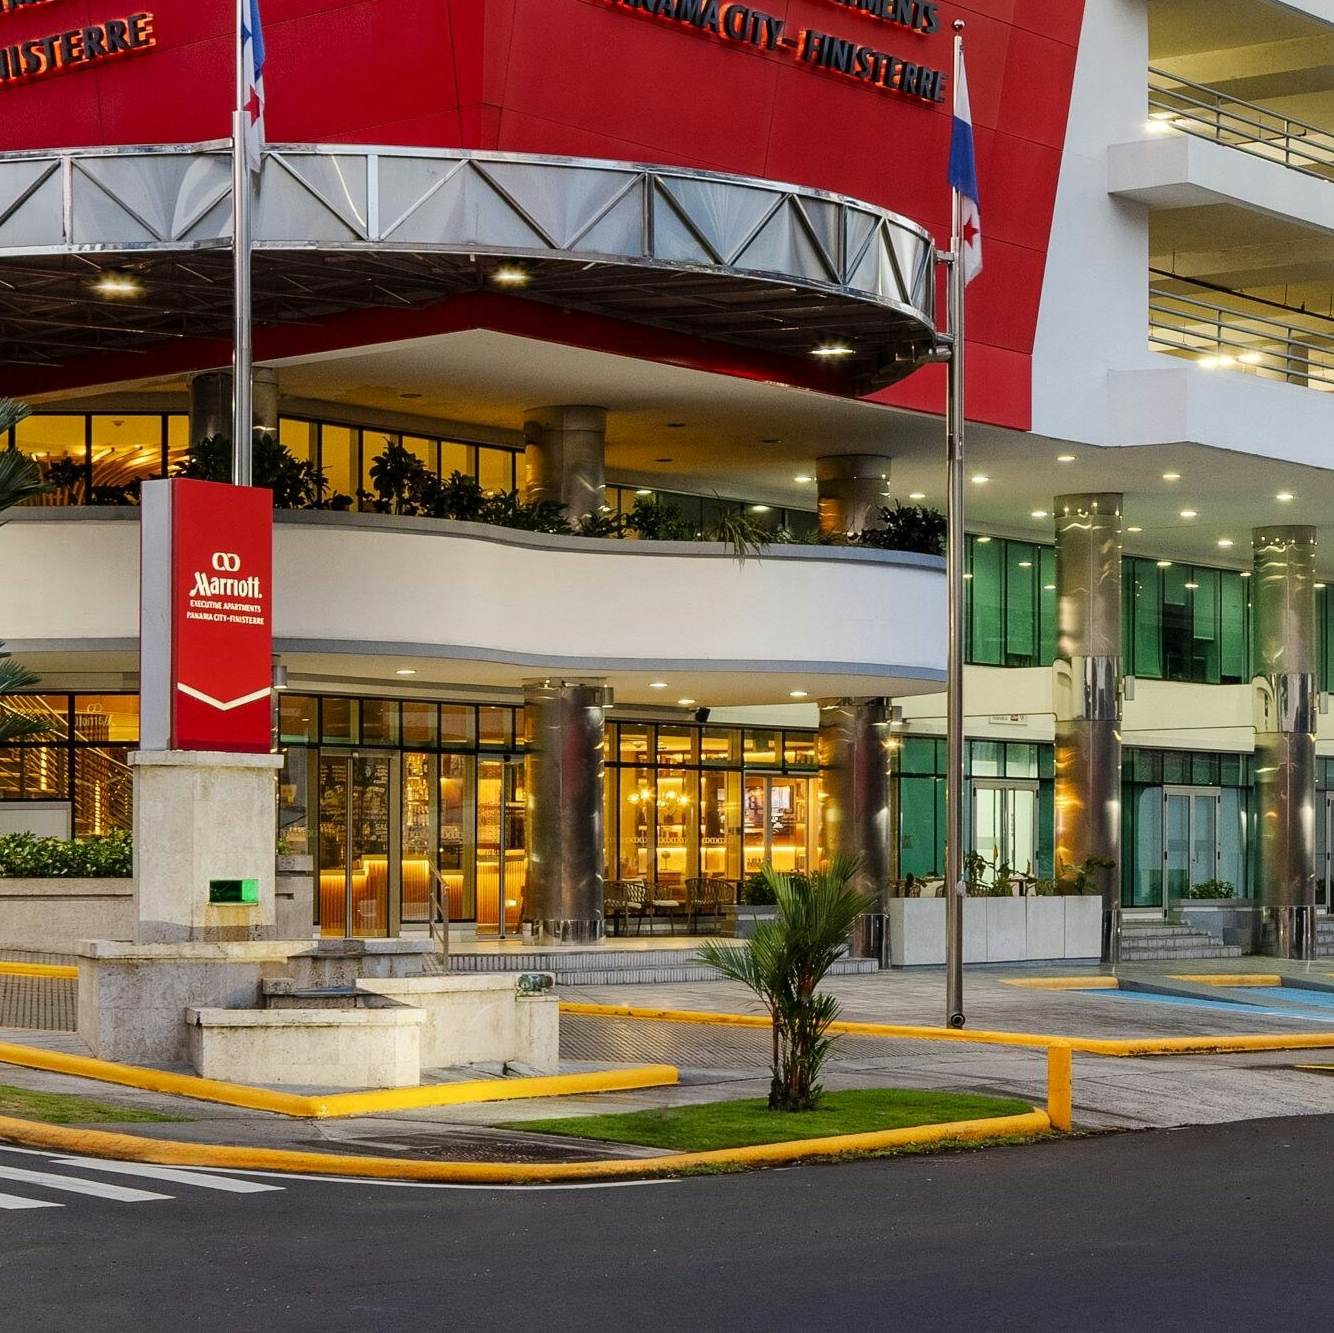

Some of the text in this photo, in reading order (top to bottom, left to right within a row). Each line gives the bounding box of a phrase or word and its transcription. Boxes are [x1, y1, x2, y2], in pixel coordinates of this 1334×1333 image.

[718, 2, 785, 50] CITY
[795, 28, 948, 104] FINISTERRE
[190, 600, 261, 613] EXECUTIVE APARTMENTS
[187, 612, 213, 621] PANAMA
